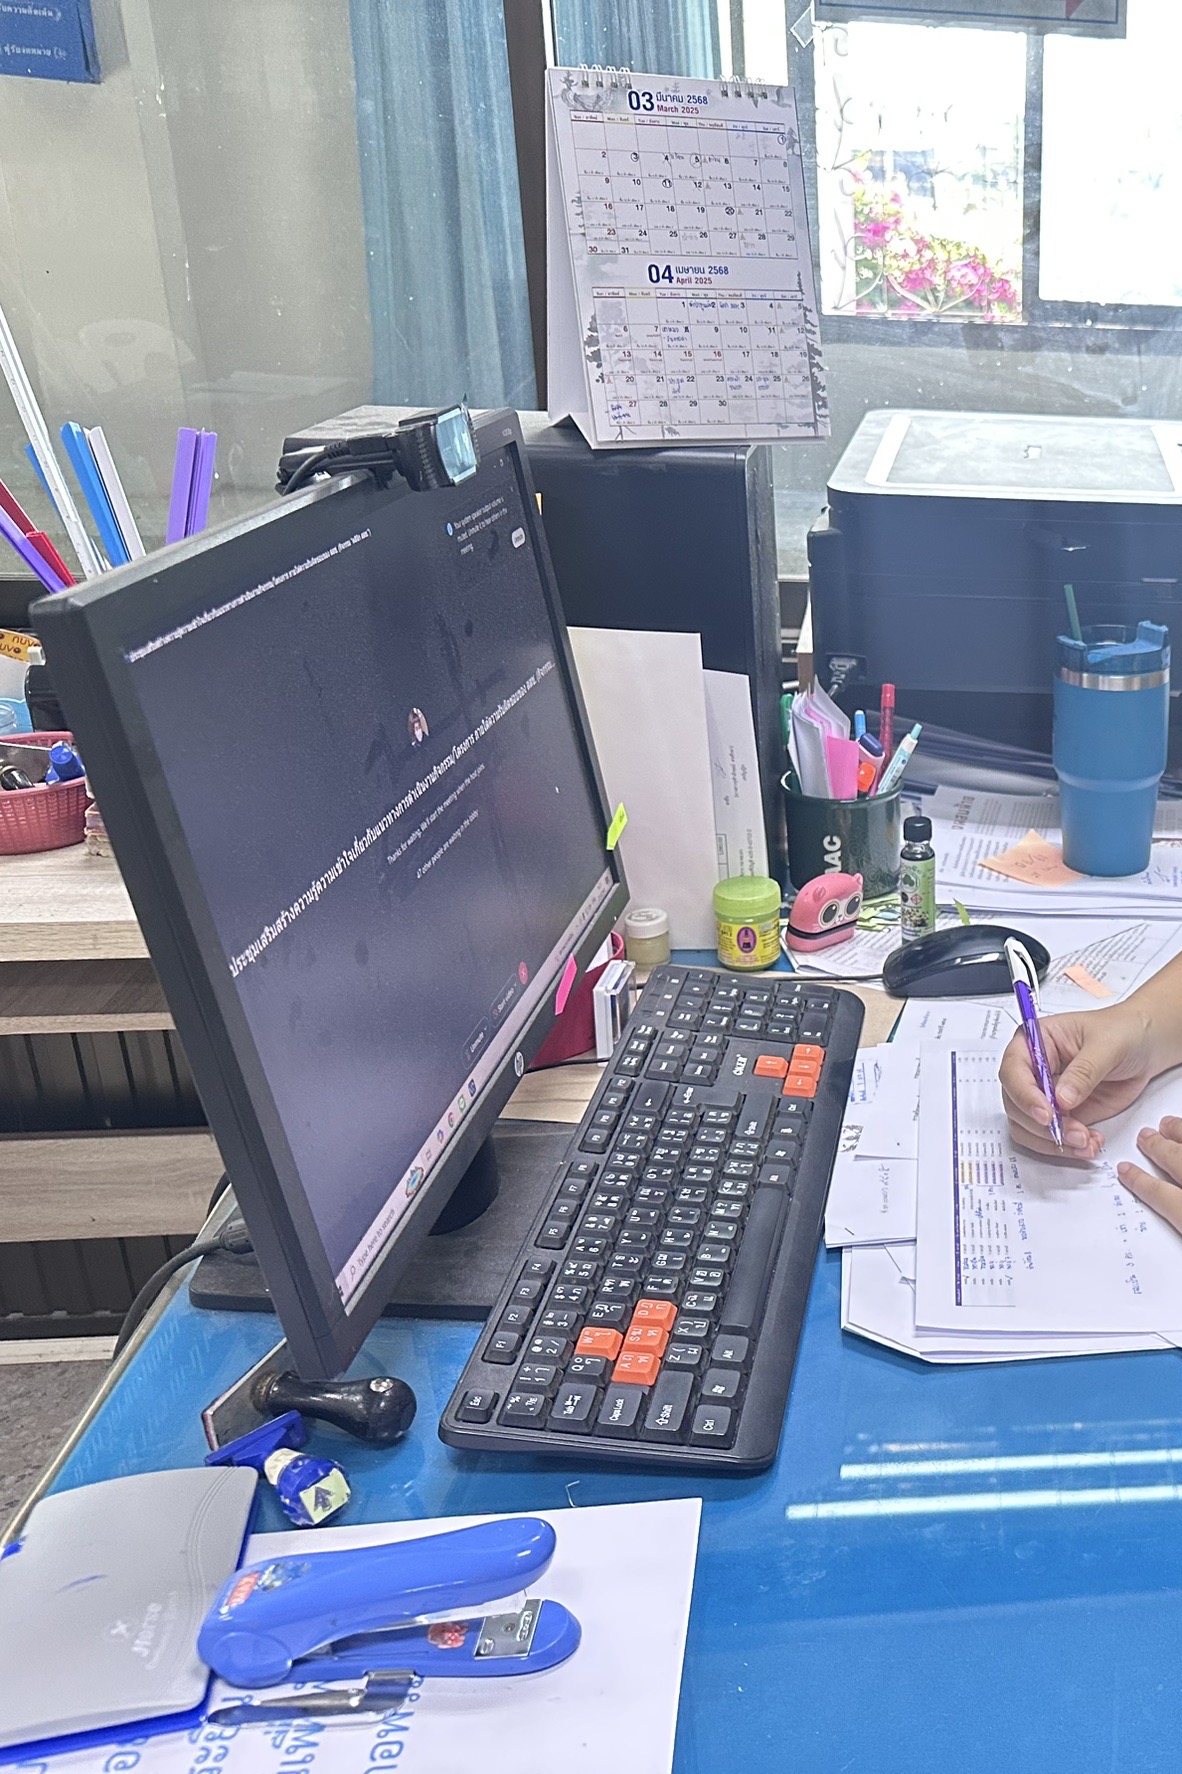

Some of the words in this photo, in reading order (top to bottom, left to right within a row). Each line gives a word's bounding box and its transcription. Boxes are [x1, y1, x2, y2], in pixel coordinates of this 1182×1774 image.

[627, 90, 655, 112] 03
[656, 91, 685, 103] มีนาคม
[687, 95, 709, 106] 2568
[657, 104, 680, 114] March
[681, 105, 700, 114] 2025
[648, 264, 674, 284] 04
[675, 266, 706, 275] เมษายน
[708, 266, 729, 276] 2568
[676, 276, 693, 286] April
[694, 277, 713, 285] 2025
[0, 643, 21, 654] uvo
[386, 844, 402, 866] Thanks
[441, 788, 457, 812] meeting
[420, 856, 432, 875] other
[429, 843, 444, 868] people
[447, 824, 462, 848] waiting
[496, 996, 506, 1015] Start
[504, 983, 514, 1004] video
[469, 1028, 484, 1055] Unmute
[357, 1246, 369, 1270] Type
[366, 1231, 378, 1253] here
[380, 1204, 396, 1232] search
[548, 1228, 559, 1236] F5
[531, 1263, 542, 1272] F4
[520, 1287, 530, 1296] F3
[508, 1312, 519, 1322] F2
[496, 1340, 506, 1349] F1
[470, 1394, 482, 1406] Esc
[563, 1402, 575, 1415] Tab
[661, 1404, 674, 1419] Shift
[702, 1419, 716, 1432] Ctrl
